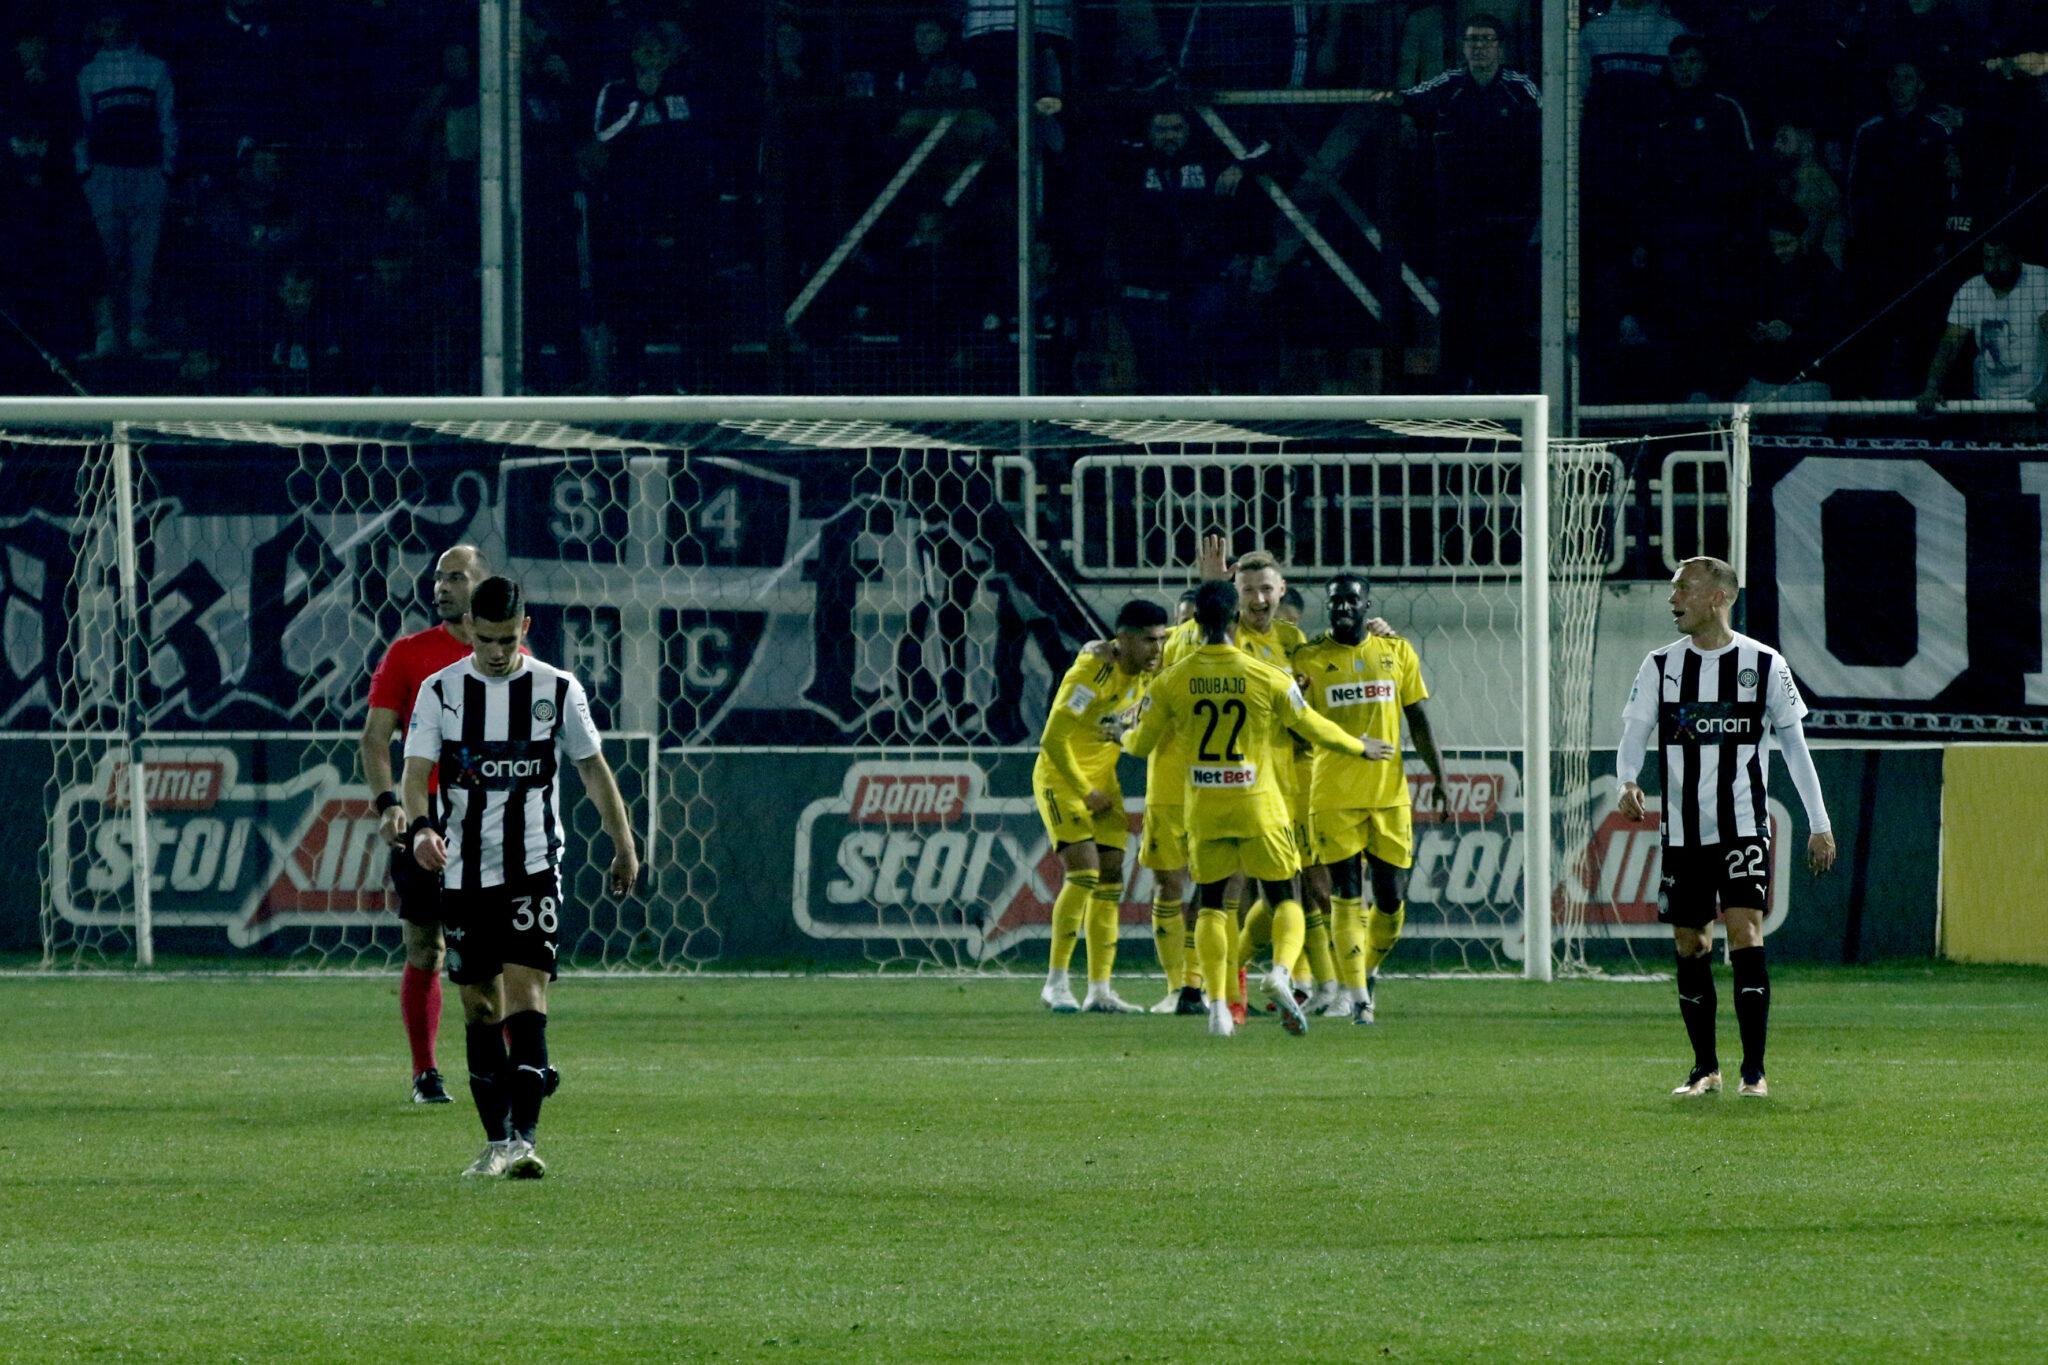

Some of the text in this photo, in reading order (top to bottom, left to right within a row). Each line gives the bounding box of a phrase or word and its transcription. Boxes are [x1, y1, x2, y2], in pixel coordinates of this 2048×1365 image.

[699, 487, 741, 549] 4
[1771, 456, 2048, 706] O
[686, 626, 730, 688] C
[1190, 677, 1246, 695] ODUBAJO
[1332, 685, 1391, 702] NetBet
[1194, 699, 1246, 761] 22
[1194, 770, 1252, 784] NetBet
[858, 781, 960, 819] pame
[1725, 844, 1766, 879] 22
[511, 896, 559, 934] 38
